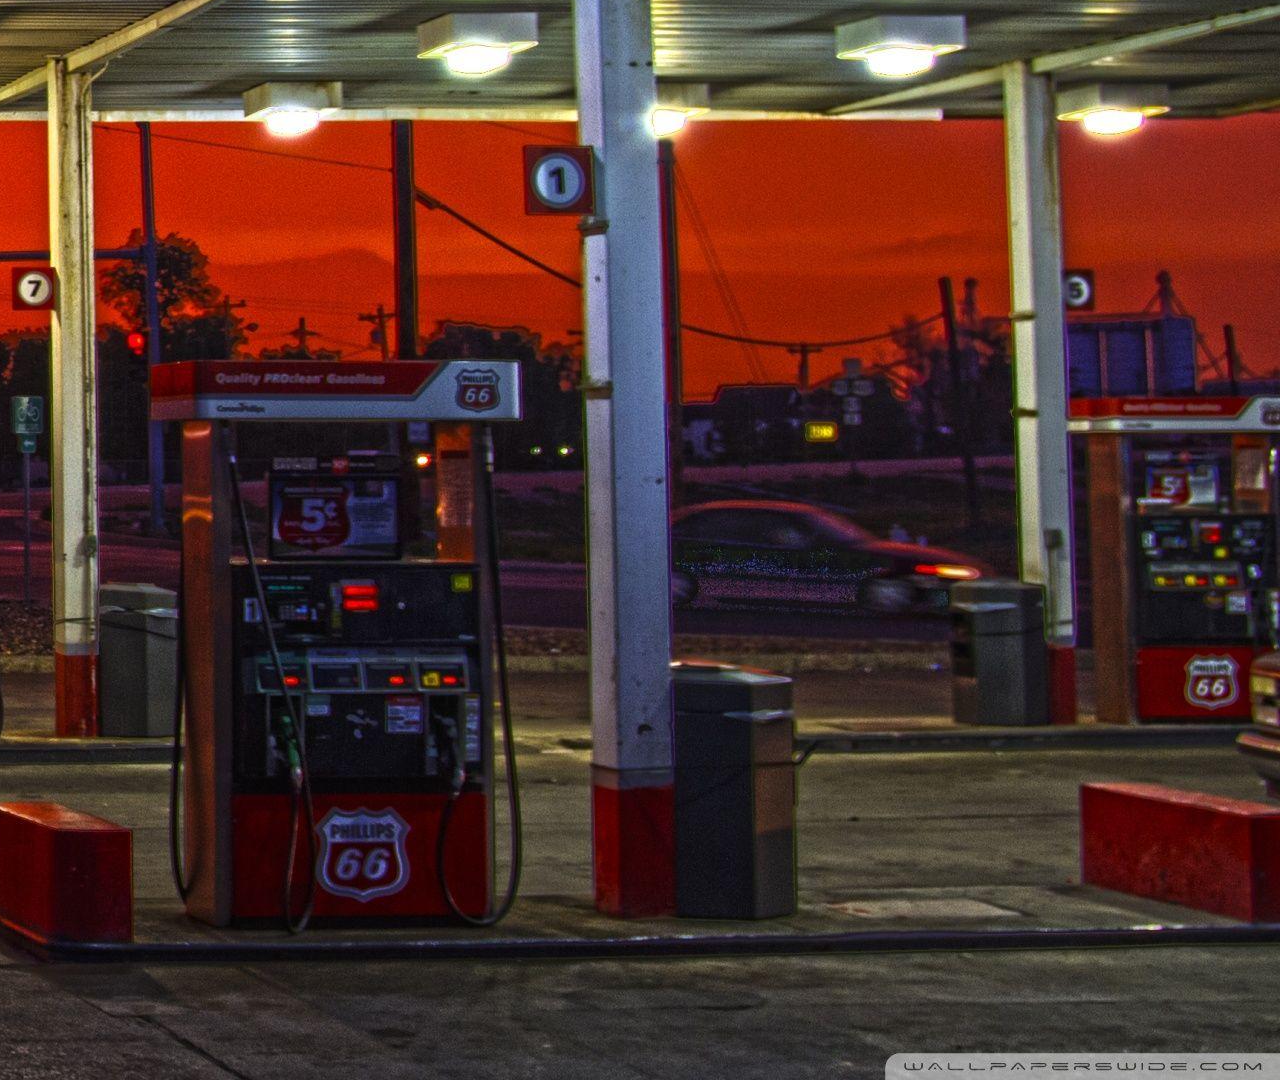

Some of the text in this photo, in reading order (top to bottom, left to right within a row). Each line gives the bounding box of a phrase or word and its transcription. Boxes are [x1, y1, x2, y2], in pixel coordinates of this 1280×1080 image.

[549, 166, 566, 195] 1
[27, 280, 42, 297] 7
[216, 373, 261, 385] Quality
[326, 373, 386, 384] Gasolines
[465, 388, 490, 403] 66
[1197, 678, 1224, 696] 66
[330, 822, 396, 839] PHILLIPS
[336, 848, 391, 880] 66
